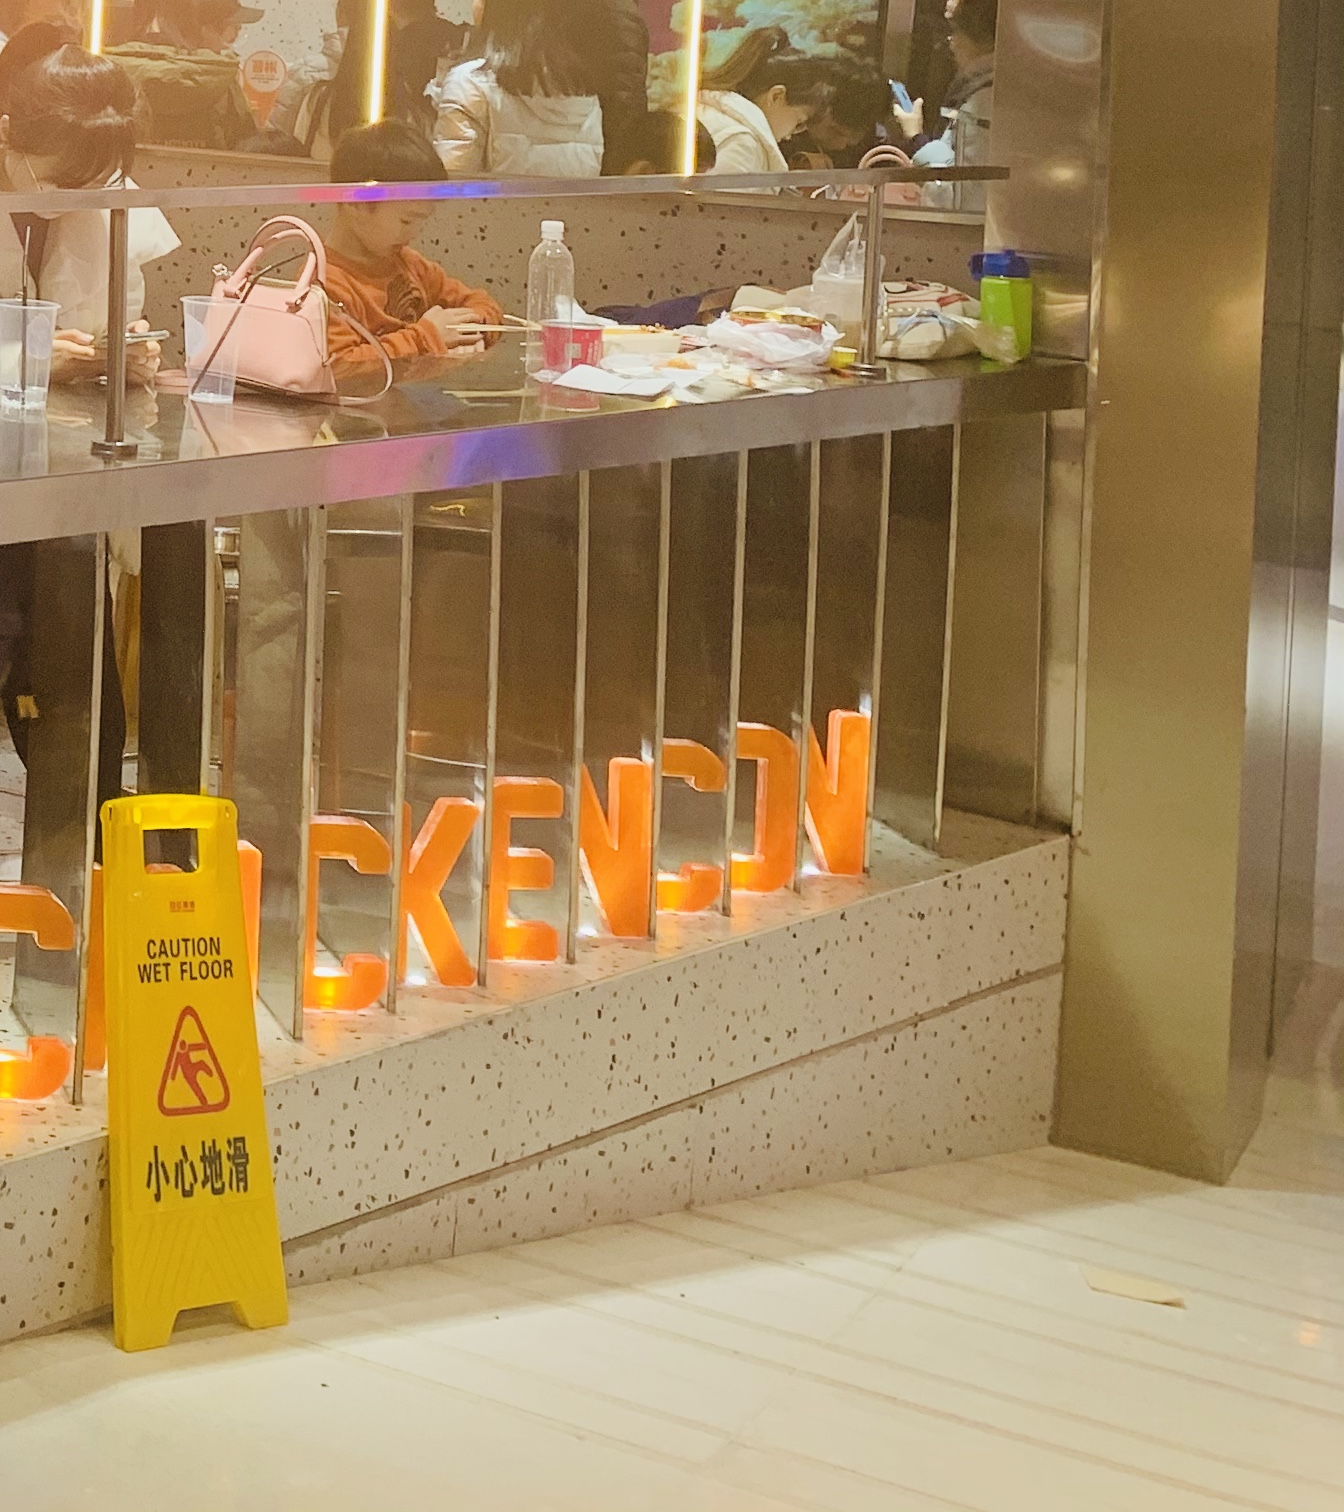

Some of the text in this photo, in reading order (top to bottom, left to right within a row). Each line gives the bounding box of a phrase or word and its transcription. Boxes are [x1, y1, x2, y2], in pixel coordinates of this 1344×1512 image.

[146, 936, 222, 961] CAUTION
[137, 958, 235, 984] WET FLOOR
[145, 1135, 250, 1203] 小心地滑
